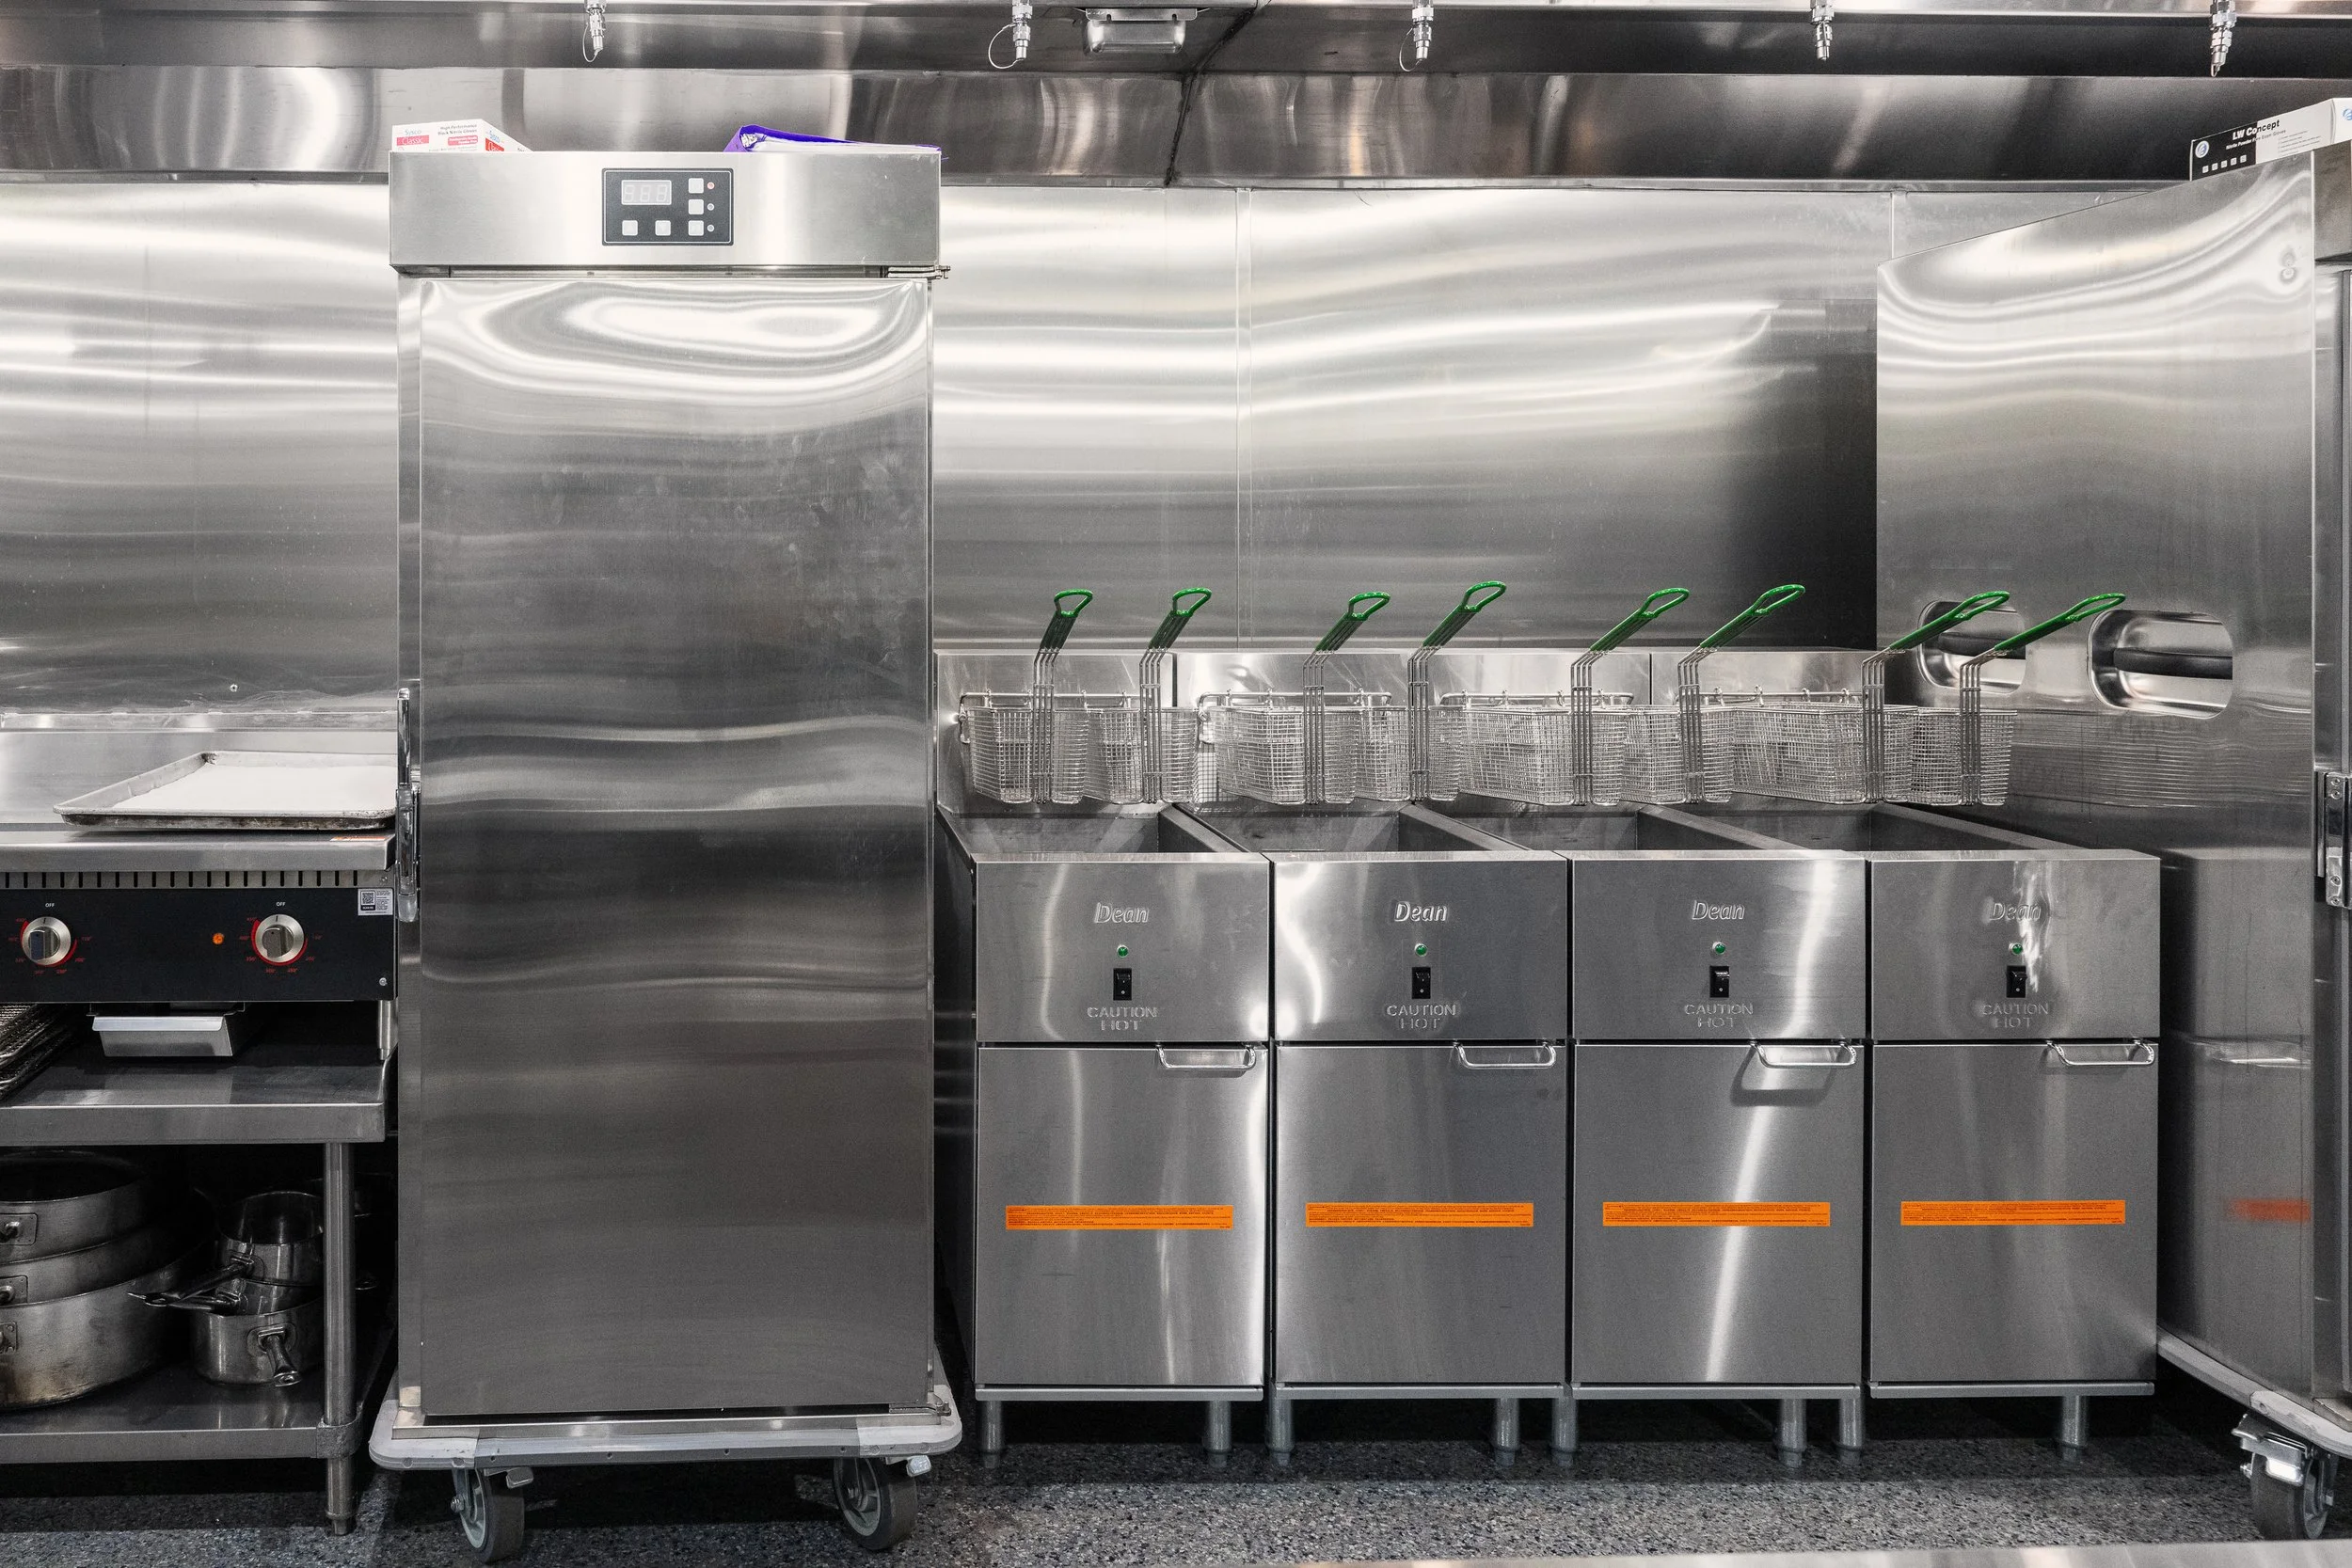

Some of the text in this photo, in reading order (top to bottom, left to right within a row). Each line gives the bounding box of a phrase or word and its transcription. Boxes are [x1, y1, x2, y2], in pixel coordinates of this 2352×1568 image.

[2232, 119, 2280, 141] LW Concept
[402, 136, 423, 145] Classic
[1094, 902, 1149, 923] Dean
[1394, 901, 1448, 922] Dean
[1692, 900, 1745, 920] Dean
[1989, 902, 2042, 921] Dean
[1087, 1007, 1158, 1018] CAUTION
[1386, 1005, 1456, 1016] CAUTION
[1684, 1004, 1754, 1015] CAUTION
[1982, 1003, 2049, 1015] CAUTION
[1101, 1020, 1141, 1030] HOT
[1400, 1018, 1440, 1029] HOT
[1697, 1017, 1737, 1028] HOT
[1994, 1017, 2032, 1028] HOT
